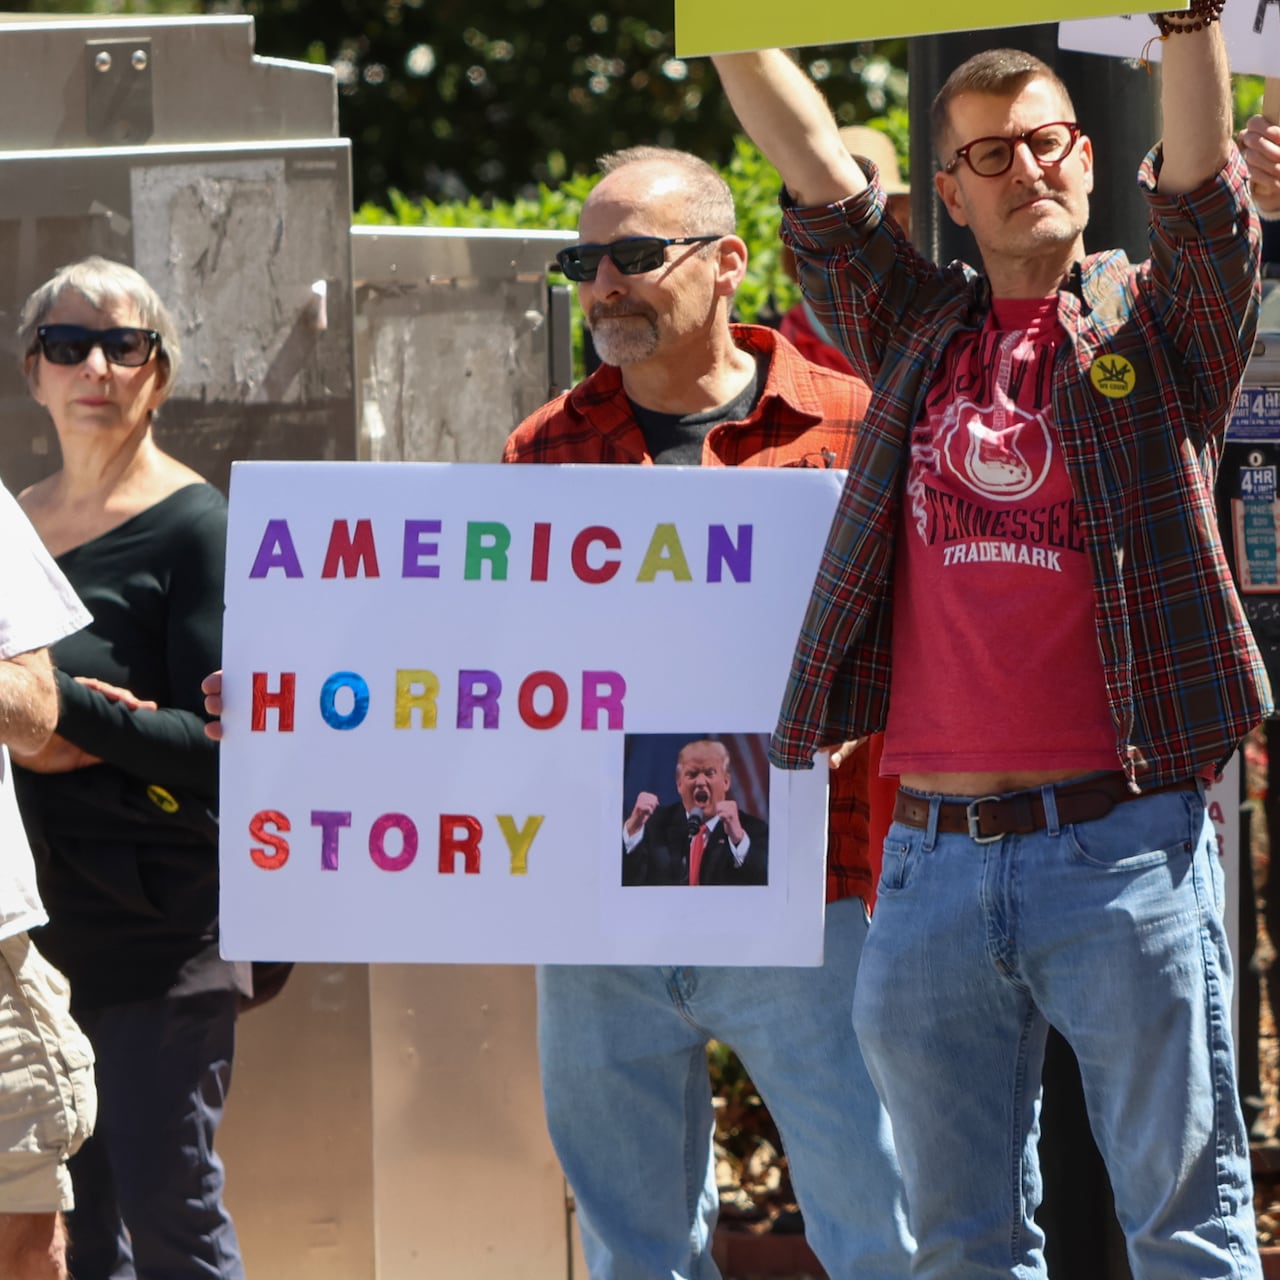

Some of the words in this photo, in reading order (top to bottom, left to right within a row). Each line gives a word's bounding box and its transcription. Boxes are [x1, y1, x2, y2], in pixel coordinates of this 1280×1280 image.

[1241, 471, 1253, 494] 4
[1253, 470, 1272, 484] HR
[249, 518, 755, 585] AMERICAN
[924, 484, 1088, 554] TENNESSEE
[943, 541, 1062, 573] TRADEMARK
[250, 668, 628, 733] HORROR
[248, 809, 547, 876] STORY
